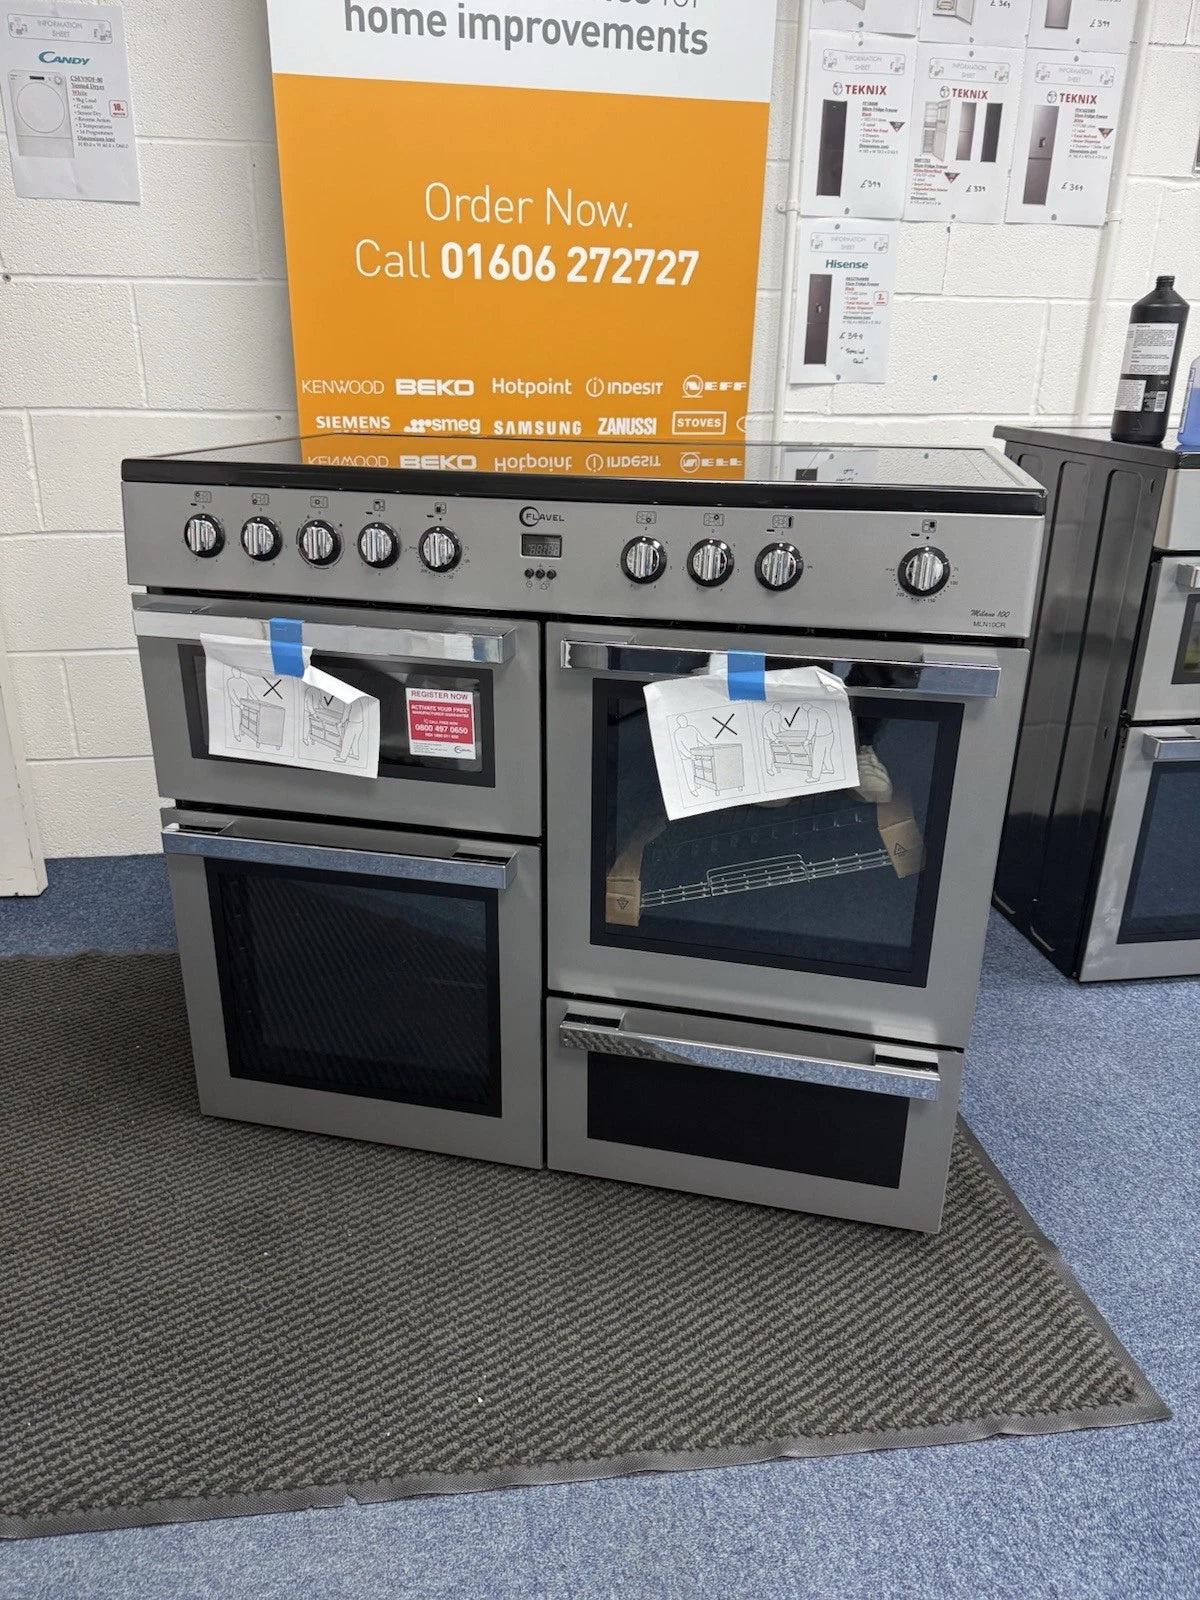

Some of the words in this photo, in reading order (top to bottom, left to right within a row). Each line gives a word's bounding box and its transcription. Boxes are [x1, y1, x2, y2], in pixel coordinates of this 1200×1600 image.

[344, 0, 446, 37] home
[458, 3, 708, 56] improvements
[845, 85, 887, 95] TEKNIX
[952, 88, 988, 99] TEKNIX
[1060, 93, 1098, 104] TEKNIX
[425, 182, 534, 224] Order
[546, 187, 633, 228] Now.
[355, 239, 430, 278] Call
[441, 241, 556, 282] 01606
[566, 246, 699, 286] 272727
[825, 259, 868, 269] Hisense
[301, 380, 384, 394] KENWOOD
[395, 378, 475, 396] BEKO
[492, 378, 572, 399] Hotpoint
[315, 416, 391, 430] SIEMENS
[433, 418, 480, 434] smeg
[494, 420, 582, 435] SAMSUNG
[598, 417, 657, 435] ZANUSSI
[676, 418, 721, 428] STOVES
[523, 510, 565, 522] FLAVEL
[411, 690, 449, 699] REGISTER
[415, 723, 433, 732] 0800
[450, 726, 468, 734] 0650
